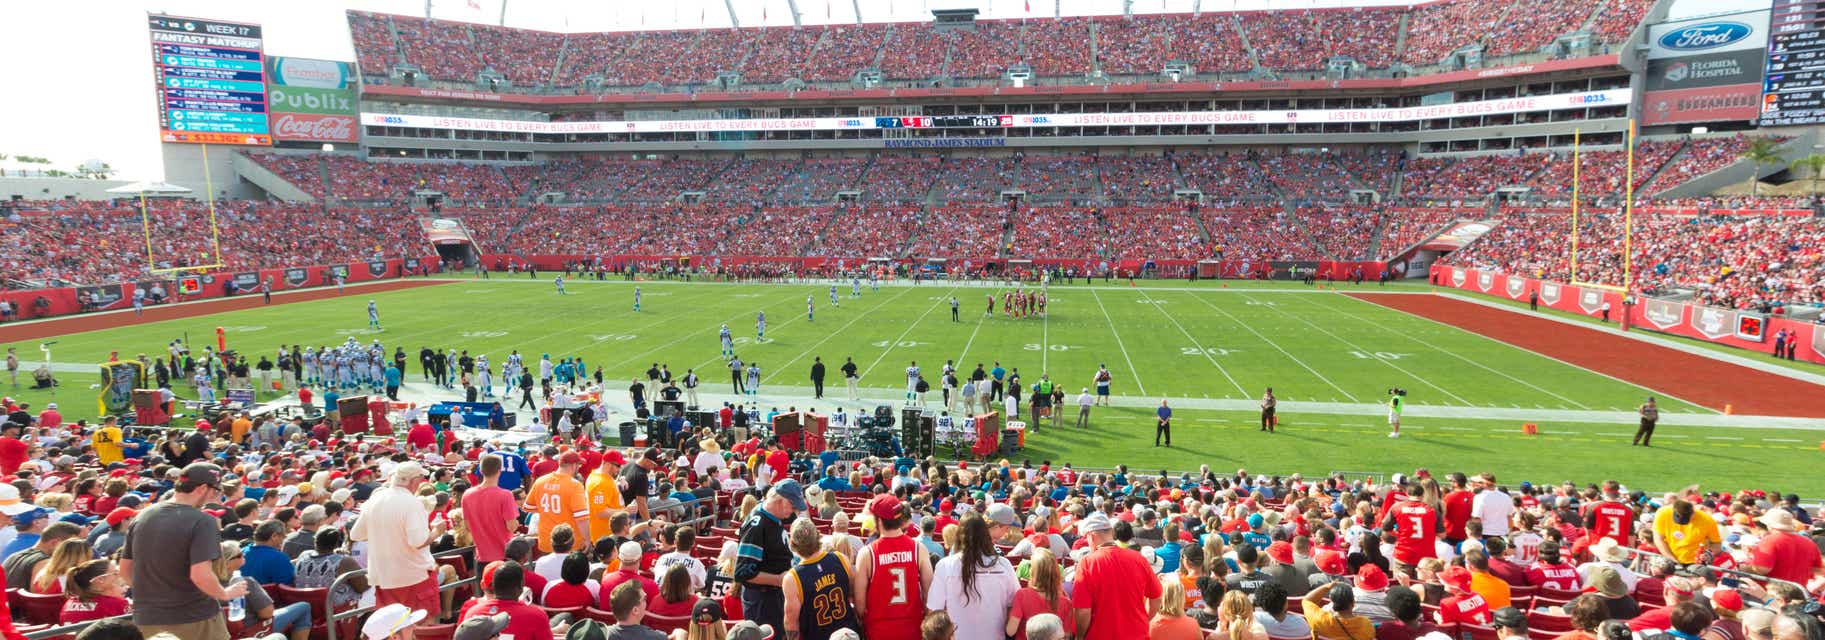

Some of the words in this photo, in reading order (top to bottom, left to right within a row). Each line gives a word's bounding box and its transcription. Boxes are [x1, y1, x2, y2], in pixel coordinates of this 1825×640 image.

[206, 24, 236, 34] WEEK
[239, 27, 250, 36] 17
[1676, 26, 1732, 47] Ford
[154, 32, 205, 44] FANTASY
[207, 37, 259, 49] MATCHUP
[1691, 60, 1738, 70] FLORIDA
[1690, 67, 1743, 79] HOSPITAL
[270, 90, 350, 111] Publix
[1328, 111, 1368, 121] LISTEN
[1371, 110, 1394, 119] LIVE
[1399, 109, 1412, 119] TO
[1416, 106, 1453, 118] EVERY
[1457, 103, 1494, 115] BUCS
[1497, 100, 1536, 111] GAME
[433, 119, 471, 128] LISTEN
[475, 121, 497, 129] LIVE
[500, 122, 513, 130] TO
[516, 123, 547, 131] EVERY
[551, 123, 574, 131] BUCS
[577, 123, 601, 131] GAME
[660, 121, 690, 130] LISTEN
[693, 121, 712, 129] LIVE
[715, 121, 727, 129] TO
[730, 121, 759, 129] EVERY
[762, 120, 787, 128] BUCS
[789, 120, 816, 128] GAME
[891, 119, 898, 127] 7
[920, 119, 931, 127] 10
[973, 118, 997, 127] 14:19
[1074, 115, 1110, 124] LISTEN
[1113, 115, 1134, 123] LIVE
[1137, 114, 1150, 123] TO
[1154, 114, 1188, 123] EVERY
[1191, 113, 1221, 122] BUCS
[1225, 113, 1256, 122] GAME
[274, 115, 352, 139] Coca-Cola
[885, 139, 931, 147] RAYMOND
[934, 138, 961, 147] JAMES
[964, 137, 1006, 147] STADIUM
[938, 418, 950, 427] 92
[540, 493, 561, 514] 40
[1409, 517, 1424, 538] 3
[1608, 516, 1620, 536] 3
[879, 551, 912, 565] WINSTON
[815, 573, 836, 592] JAMES
[888, 567, 908, 604] 3
[813, 586, 848, 626] 23
